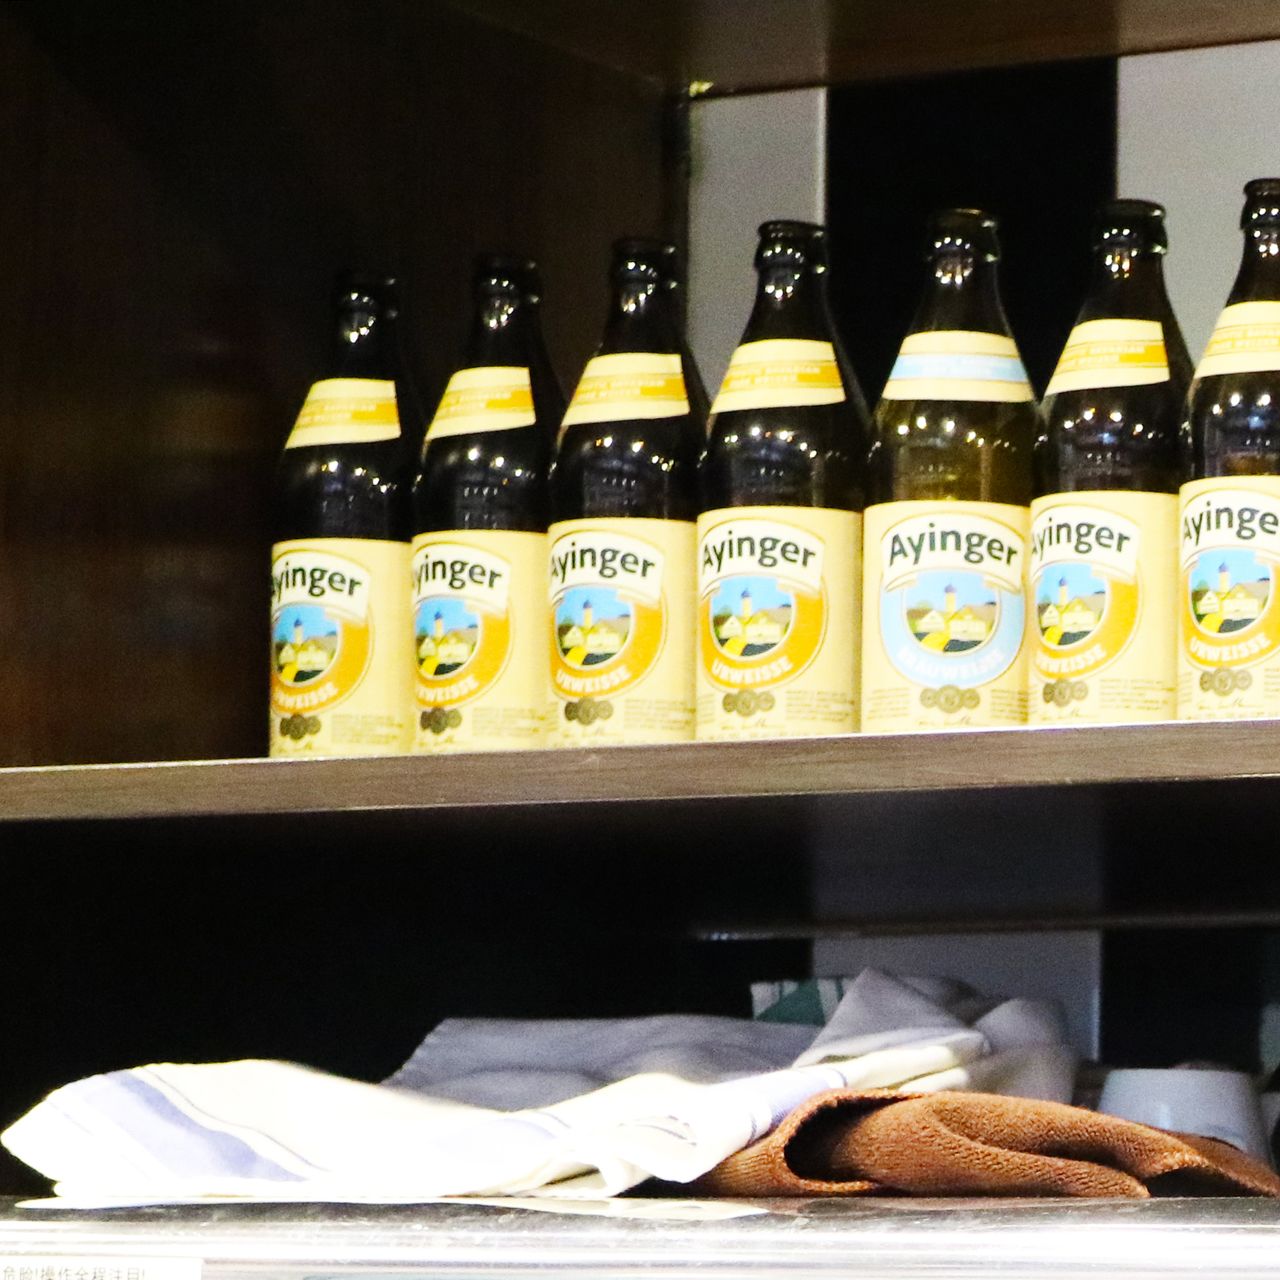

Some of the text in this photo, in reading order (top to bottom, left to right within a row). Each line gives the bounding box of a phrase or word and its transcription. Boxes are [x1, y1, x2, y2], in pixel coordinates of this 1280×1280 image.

[703, 530, 816, 575] Ayinger
[889, 522, 1018, 567] Ayinger
[272, 561, 363, 601] yinger
[412, 554, 502, 595] yinger
